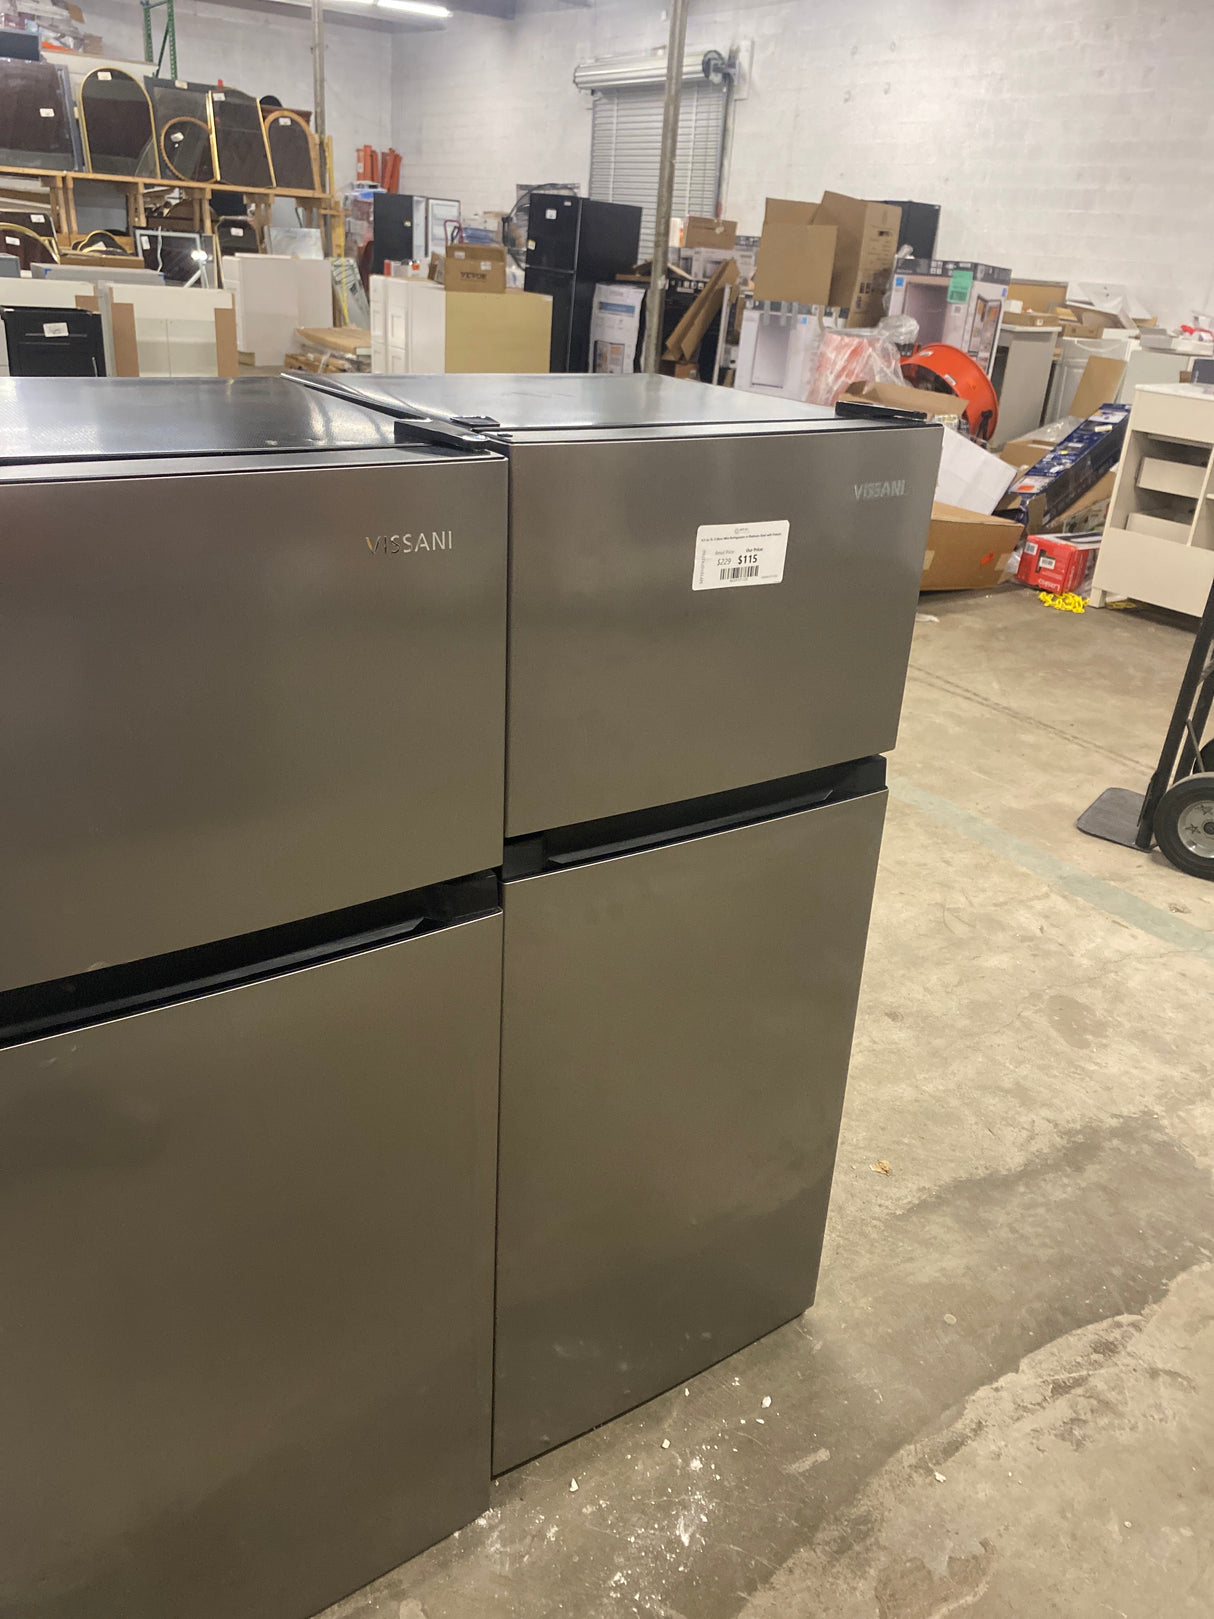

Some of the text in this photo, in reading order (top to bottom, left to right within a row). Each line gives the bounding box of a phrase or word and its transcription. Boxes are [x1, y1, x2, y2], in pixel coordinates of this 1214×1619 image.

[854, 479, 905, 500] VISSANI
[365, 531, 452, 554] VISSANI
[717, 554, 758, 566] $229 $115
